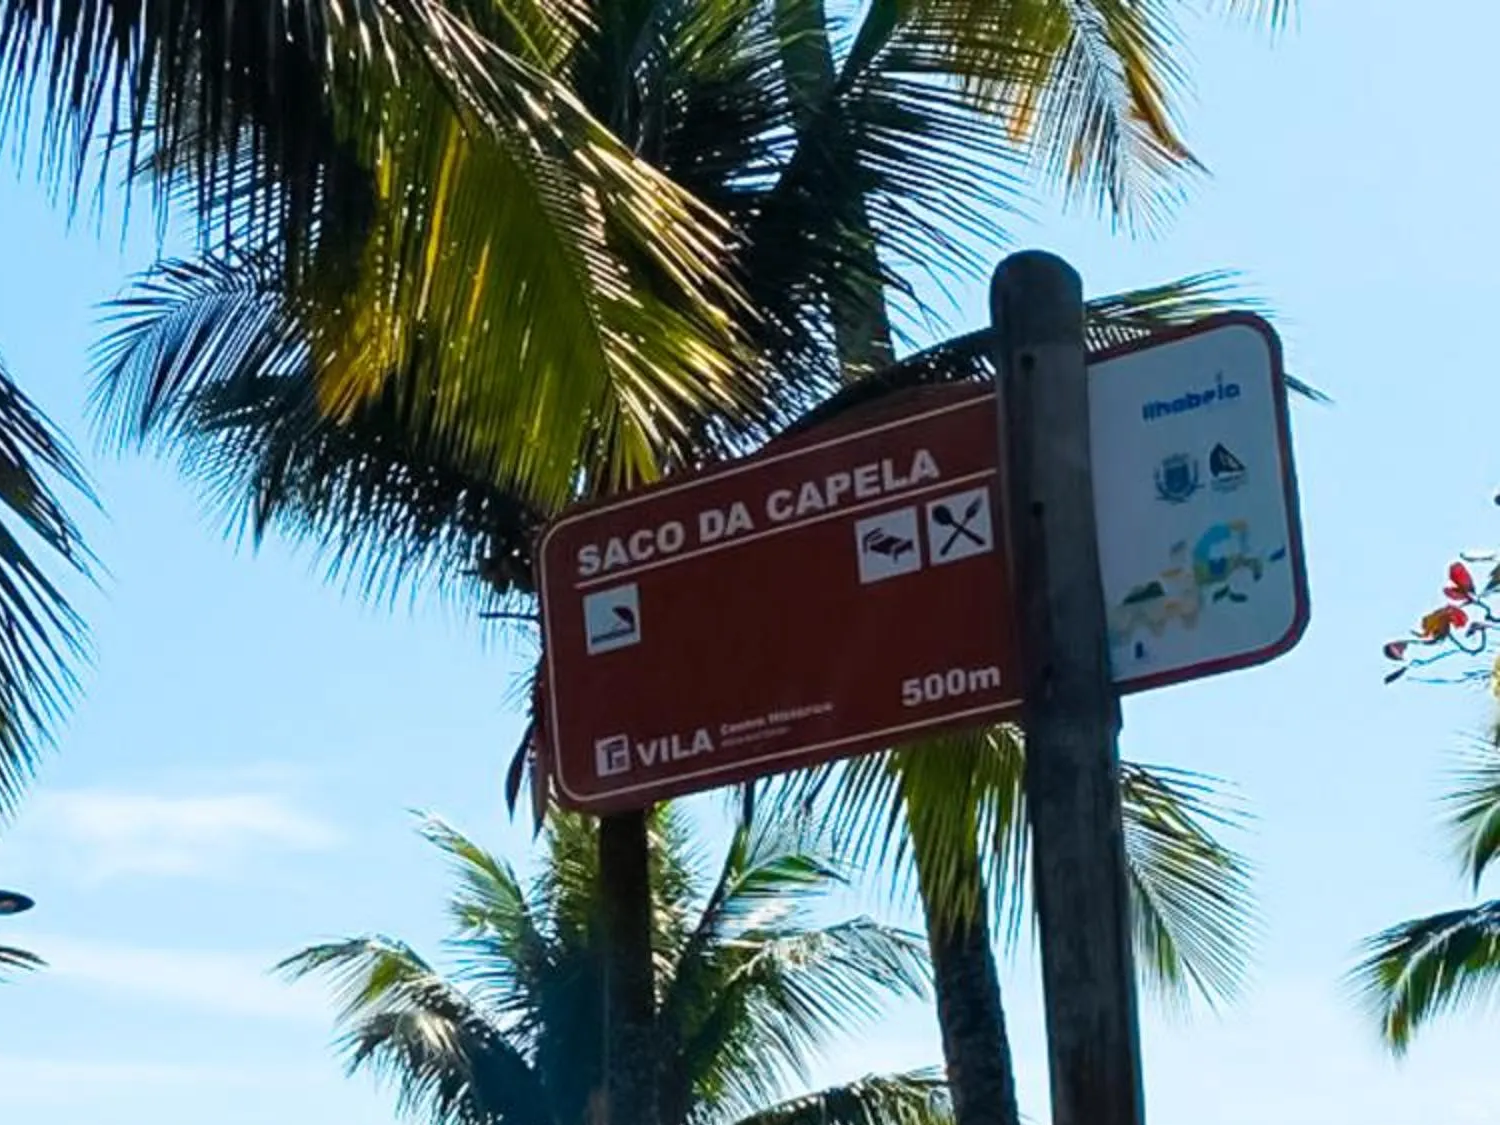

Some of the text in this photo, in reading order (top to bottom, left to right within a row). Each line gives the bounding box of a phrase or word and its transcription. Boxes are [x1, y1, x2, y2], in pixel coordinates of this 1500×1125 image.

[577, 448, 940, 577] SACO DA CAPELA
[901, 665, 1001, 707] 500m
[636, 728, 715, 767] VILA
